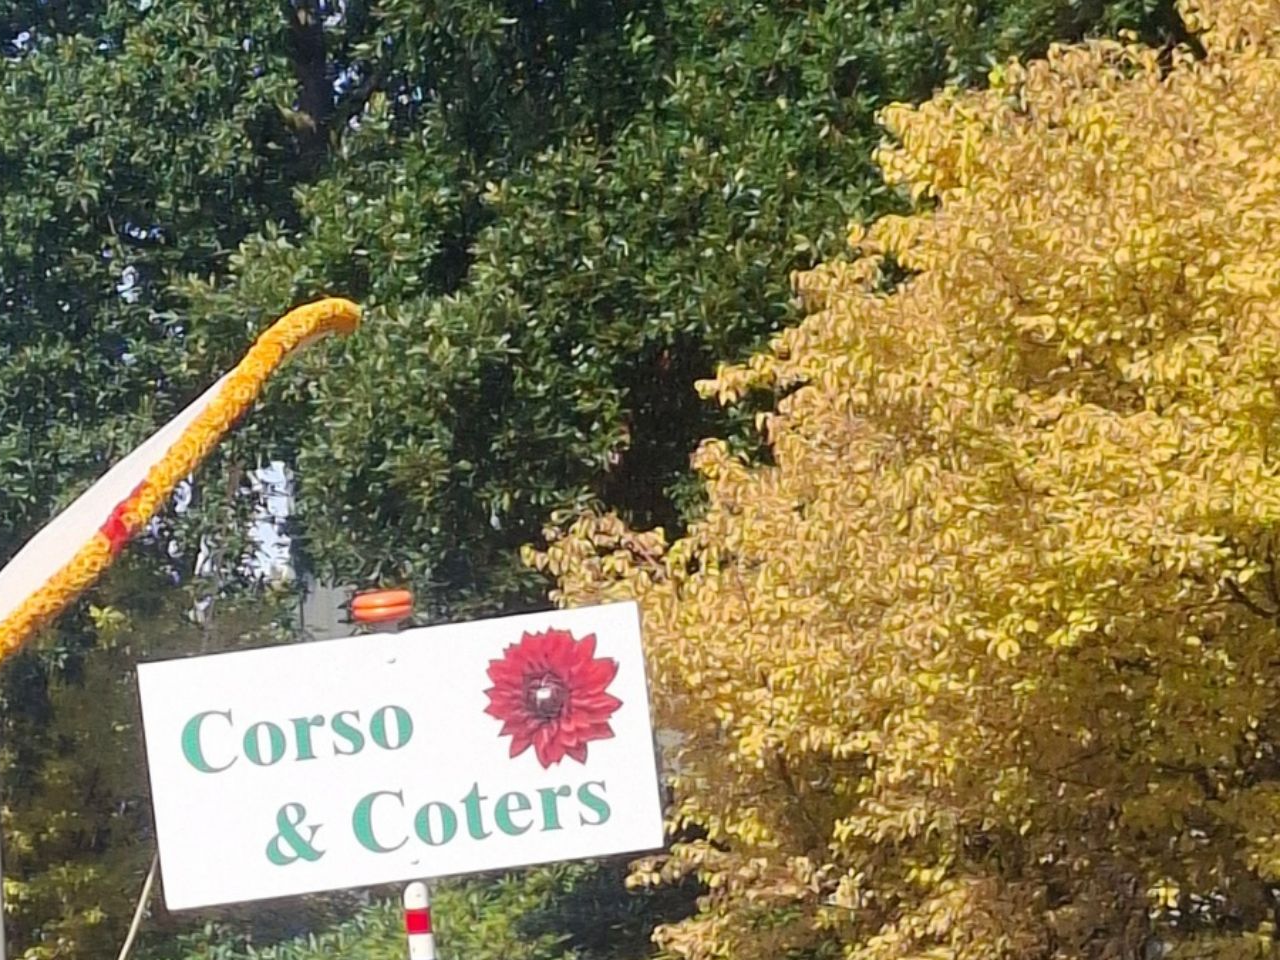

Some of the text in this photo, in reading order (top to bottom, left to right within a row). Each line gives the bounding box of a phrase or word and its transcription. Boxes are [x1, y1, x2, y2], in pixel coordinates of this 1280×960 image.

[181, 704, 414, 774] Corso
[265, 779, 612, 866] & Coters
